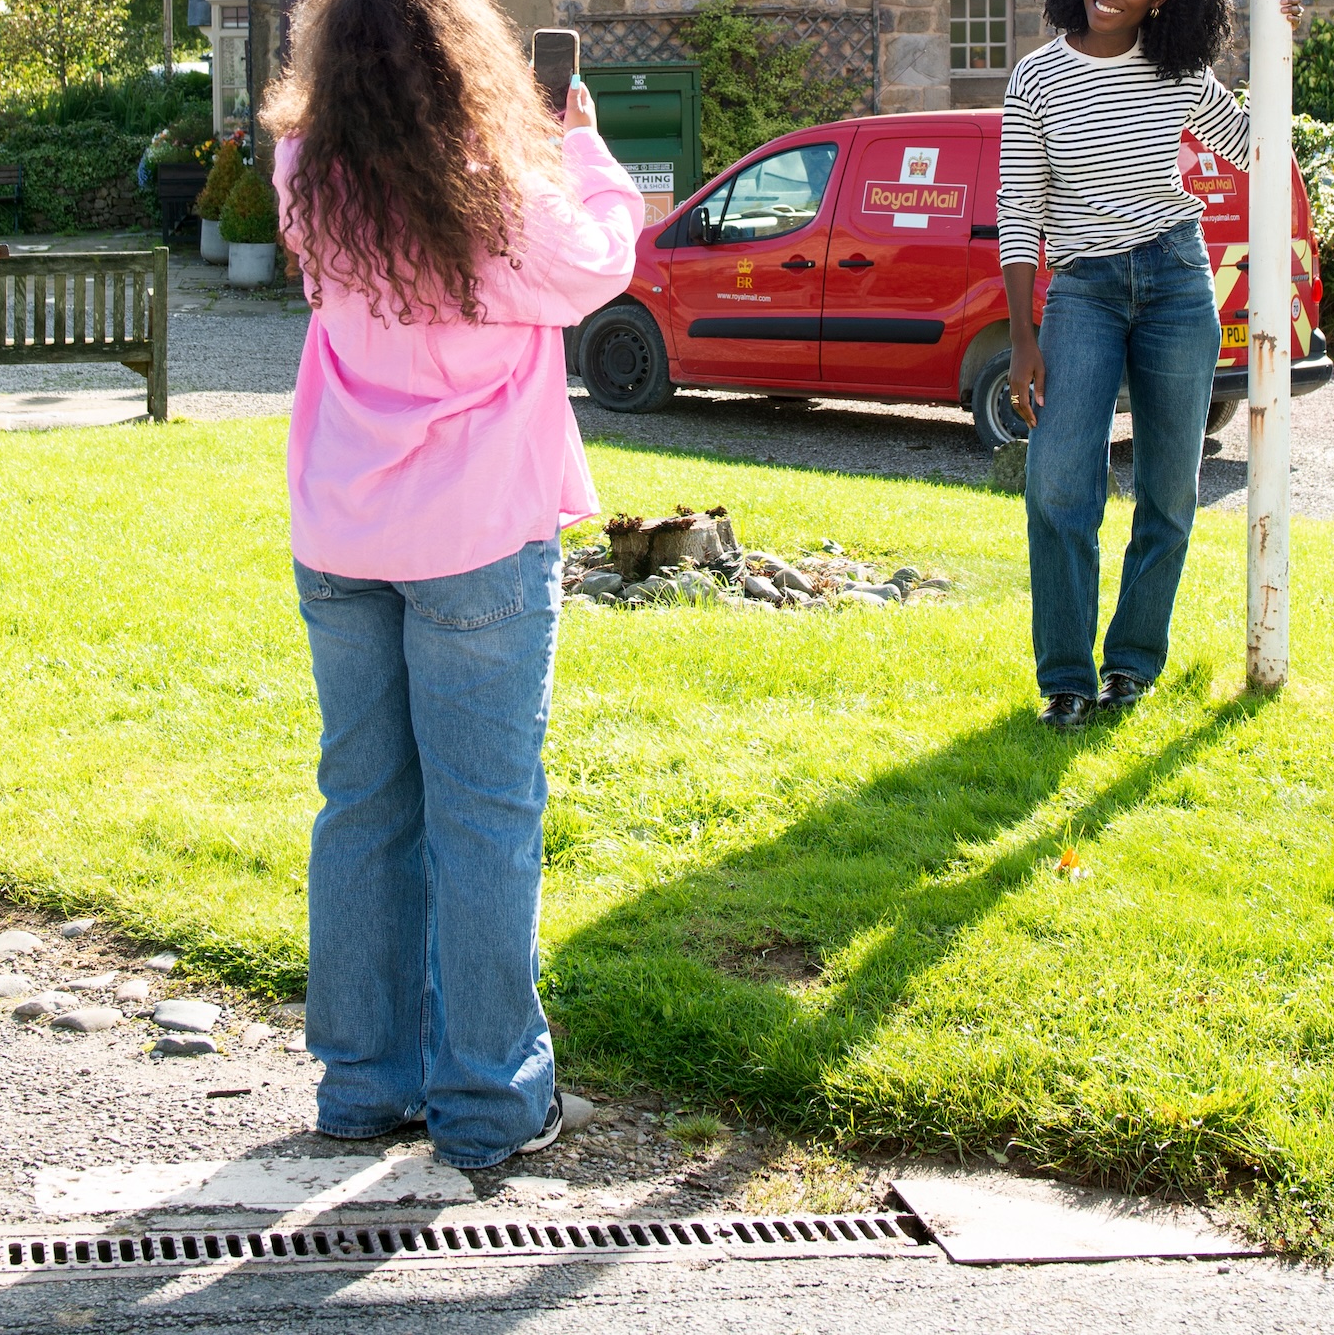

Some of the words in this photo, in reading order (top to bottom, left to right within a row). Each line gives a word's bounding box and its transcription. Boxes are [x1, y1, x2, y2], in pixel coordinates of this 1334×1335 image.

[1192, 178, 1216, 193] Royal
[1215, 178, 1233, 190] Mail
[870, 187, 918, 210] Royal
[920, 190, 959, 208] Mail
[716, 293, 771, 302] www.royalmail.com
[1227, 326, 1246, 343] POJ
